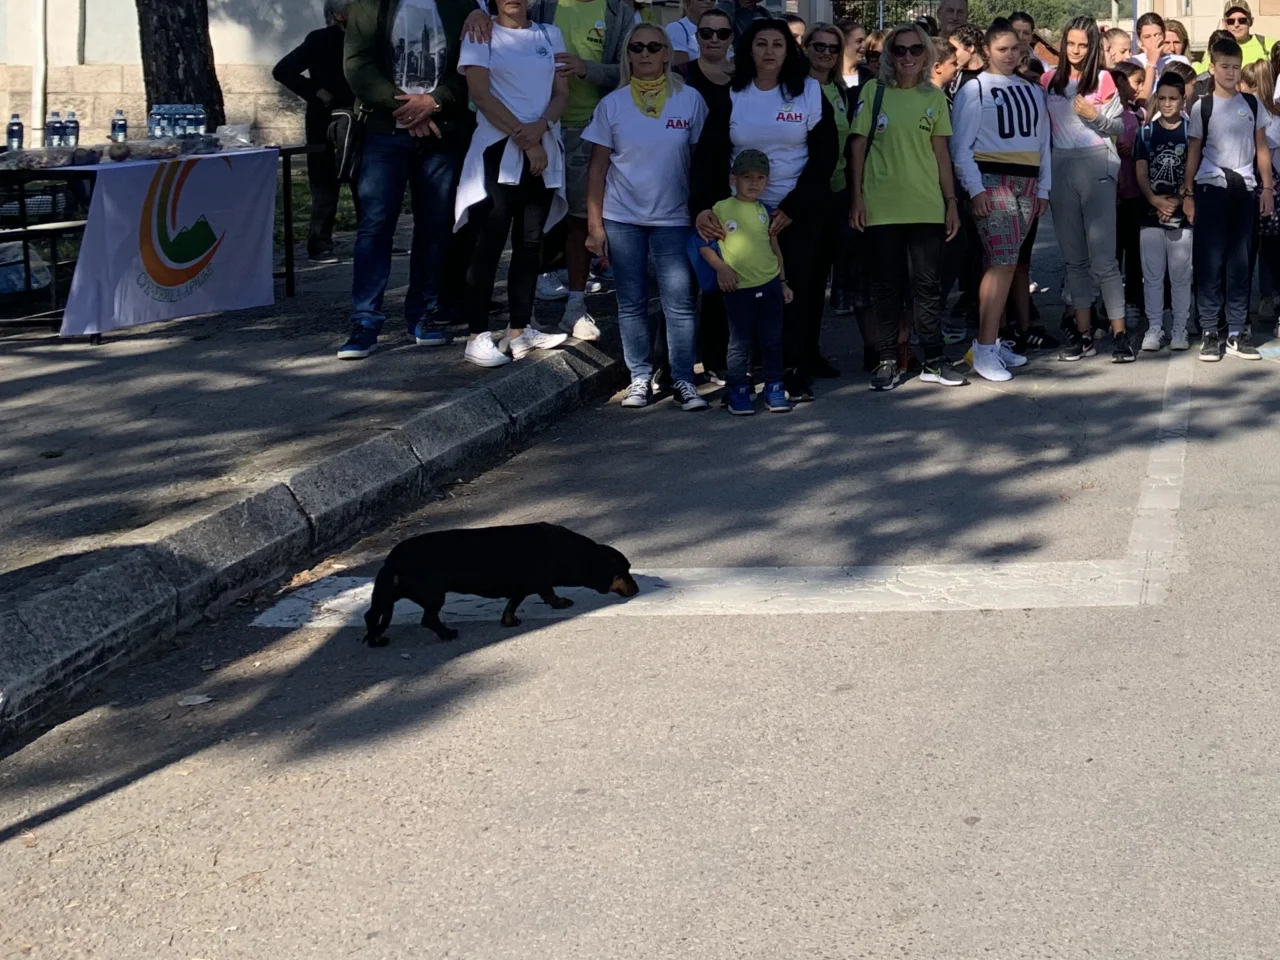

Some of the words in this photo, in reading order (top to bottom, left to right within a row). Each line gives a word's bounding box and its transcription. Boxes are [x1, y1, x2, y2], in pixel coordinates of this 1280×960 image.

[776, 112, 803, 122] ДАН
[990, 85, 1039, 140] OUI
[665, 119, 690, 130] ДАН
